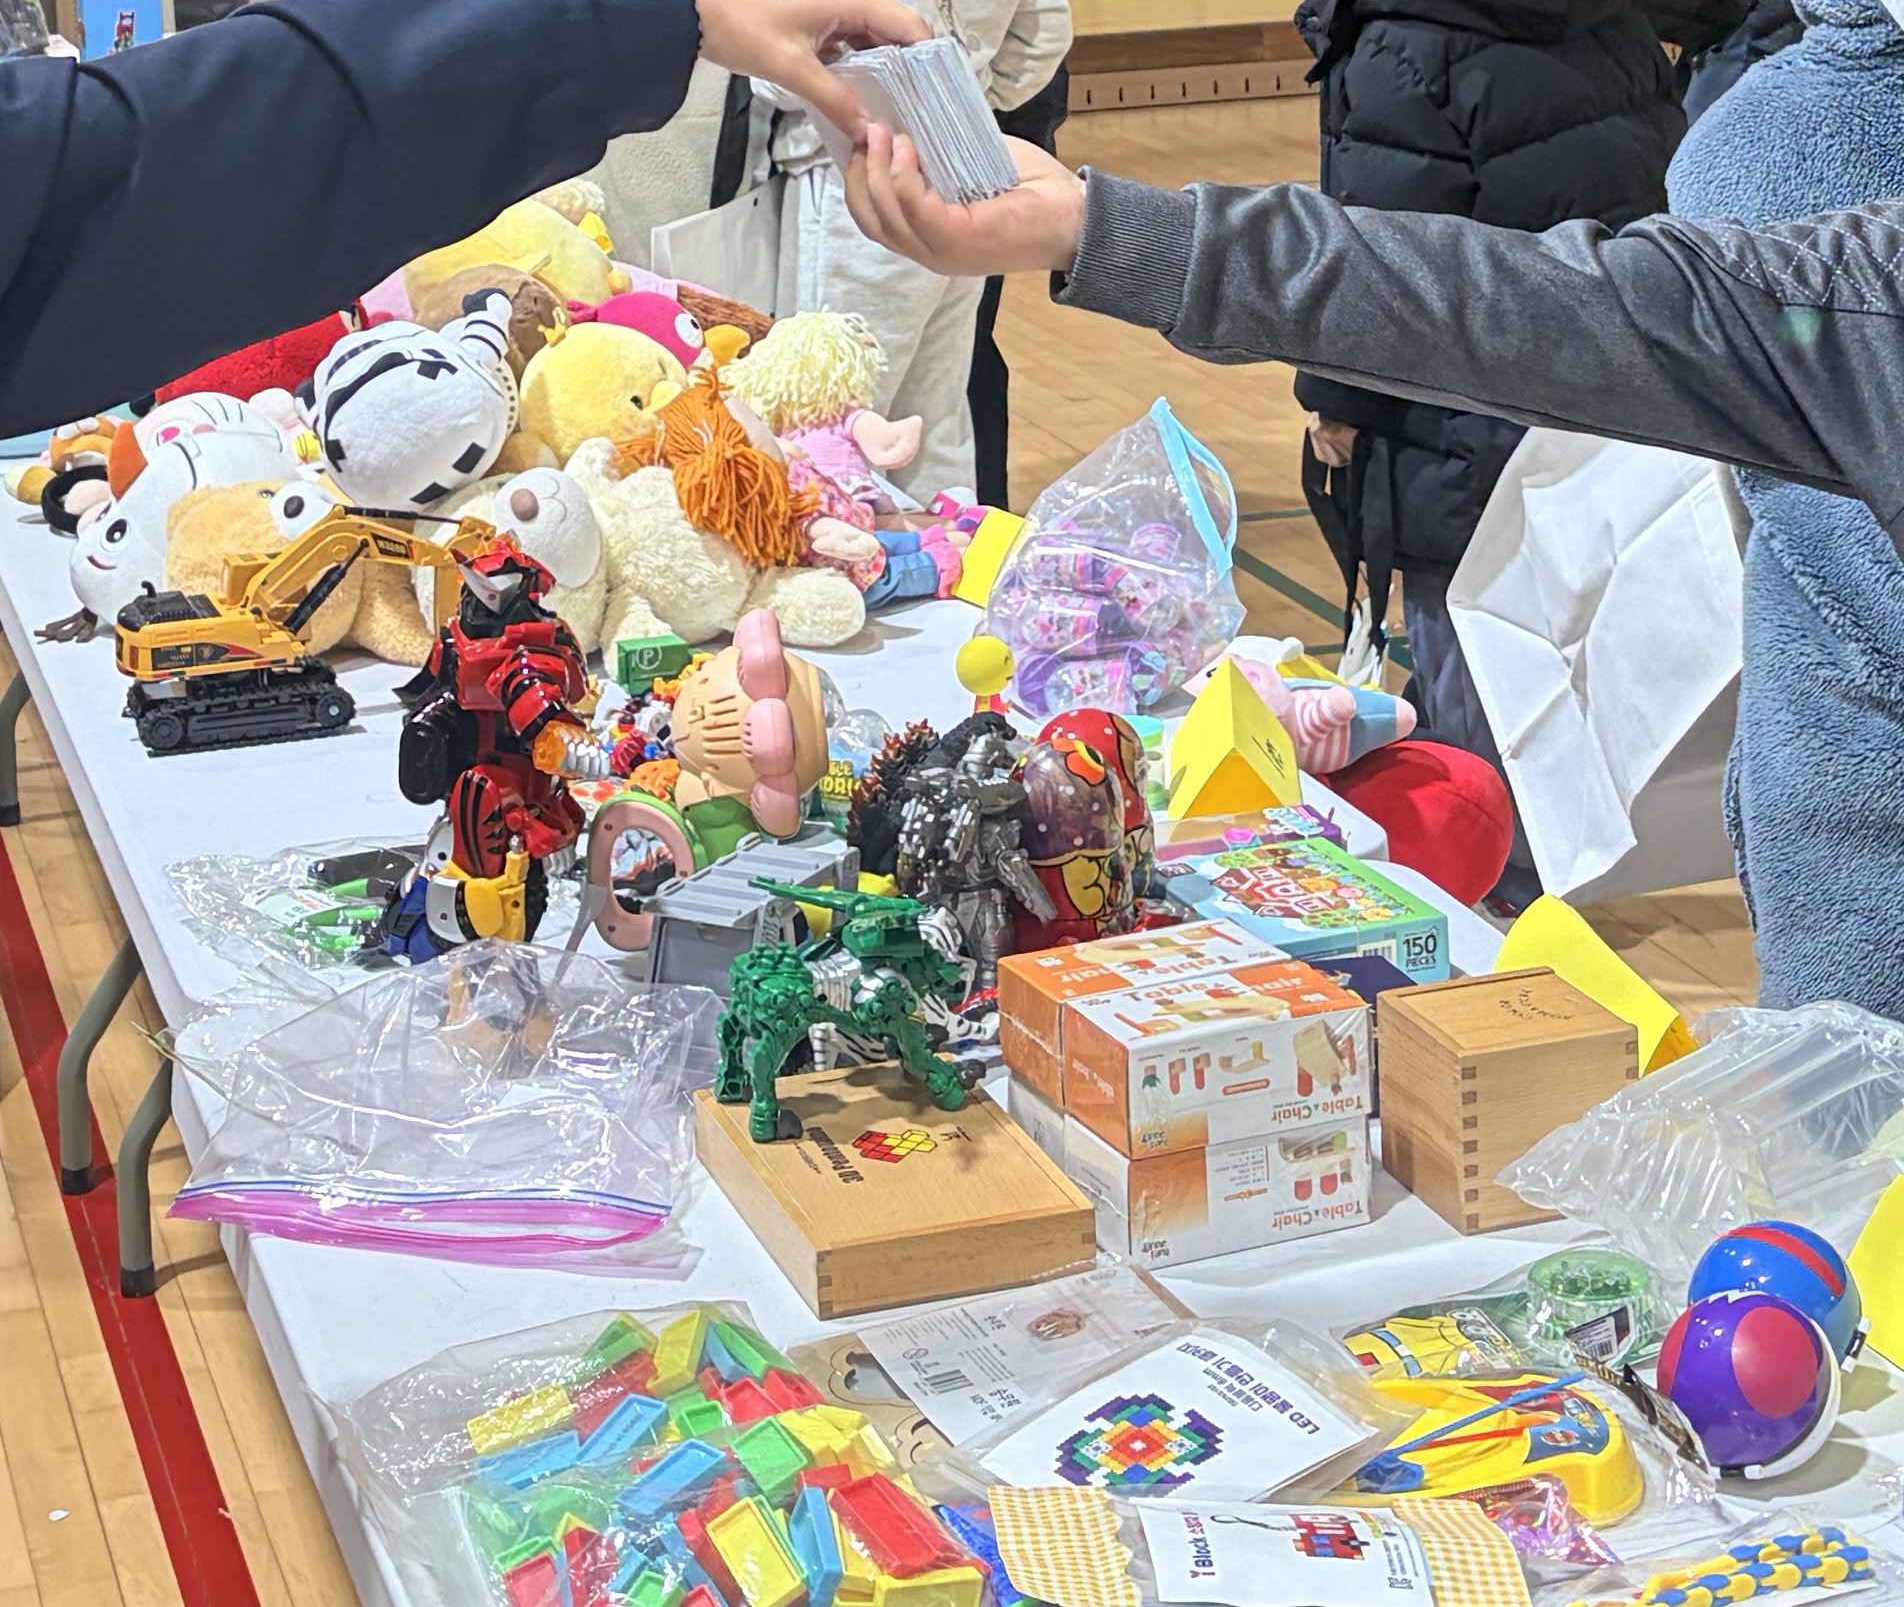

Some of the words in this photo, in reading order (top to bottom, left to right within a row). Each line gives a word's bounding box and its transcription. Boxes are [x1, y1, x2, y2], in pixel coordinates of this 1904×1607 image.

[1402, 934, 1438, 957] 150
[1152, 956, 1238, 975] Table
[1122, 981, 1209, 1002] Table
[1270, 1105, 1313, 1123] Chair
[1321, 1095, 1364, 1114] Table
[1321, 1199, 1364, 1219] Table
[1271, 1210, 1313, 1229] Chair
[1288, 1411, 1321, 1435] LED
